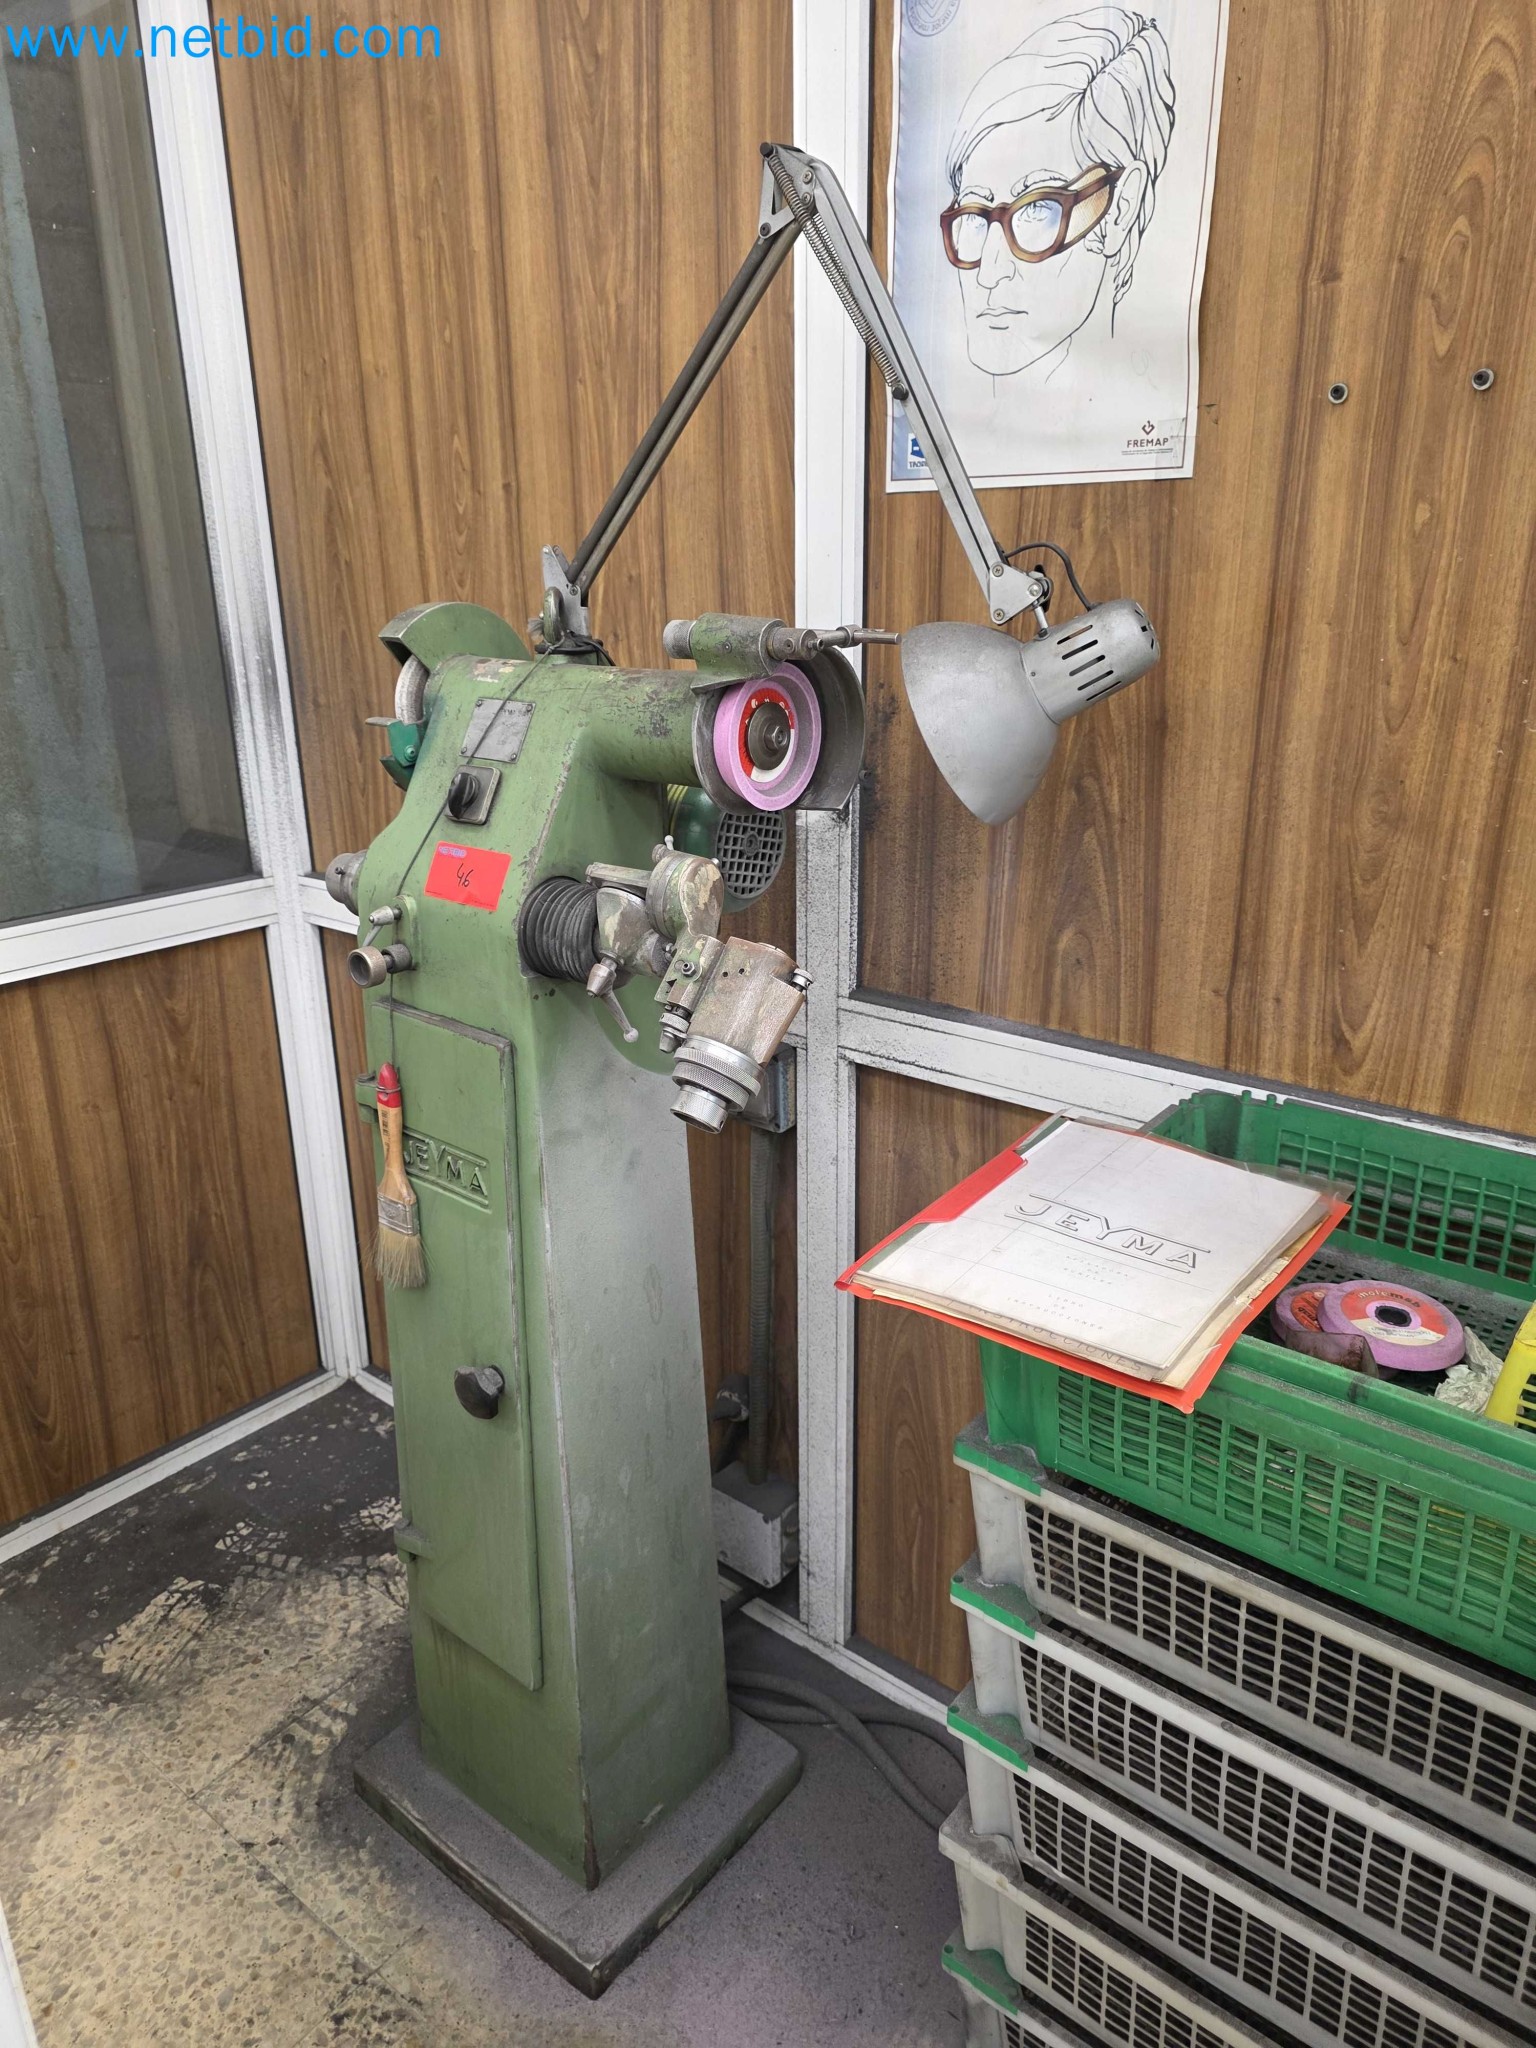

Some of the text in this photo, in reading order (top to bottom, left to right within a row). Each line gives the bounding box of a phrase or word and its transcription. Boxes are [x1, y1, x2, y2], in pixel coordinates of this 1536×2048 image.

[1127, 437, 1169, 448] FREMAP
[403, 1139, 488, 1197] JEYMA
[1014, 1203, 1197, 1269] JEYMA
